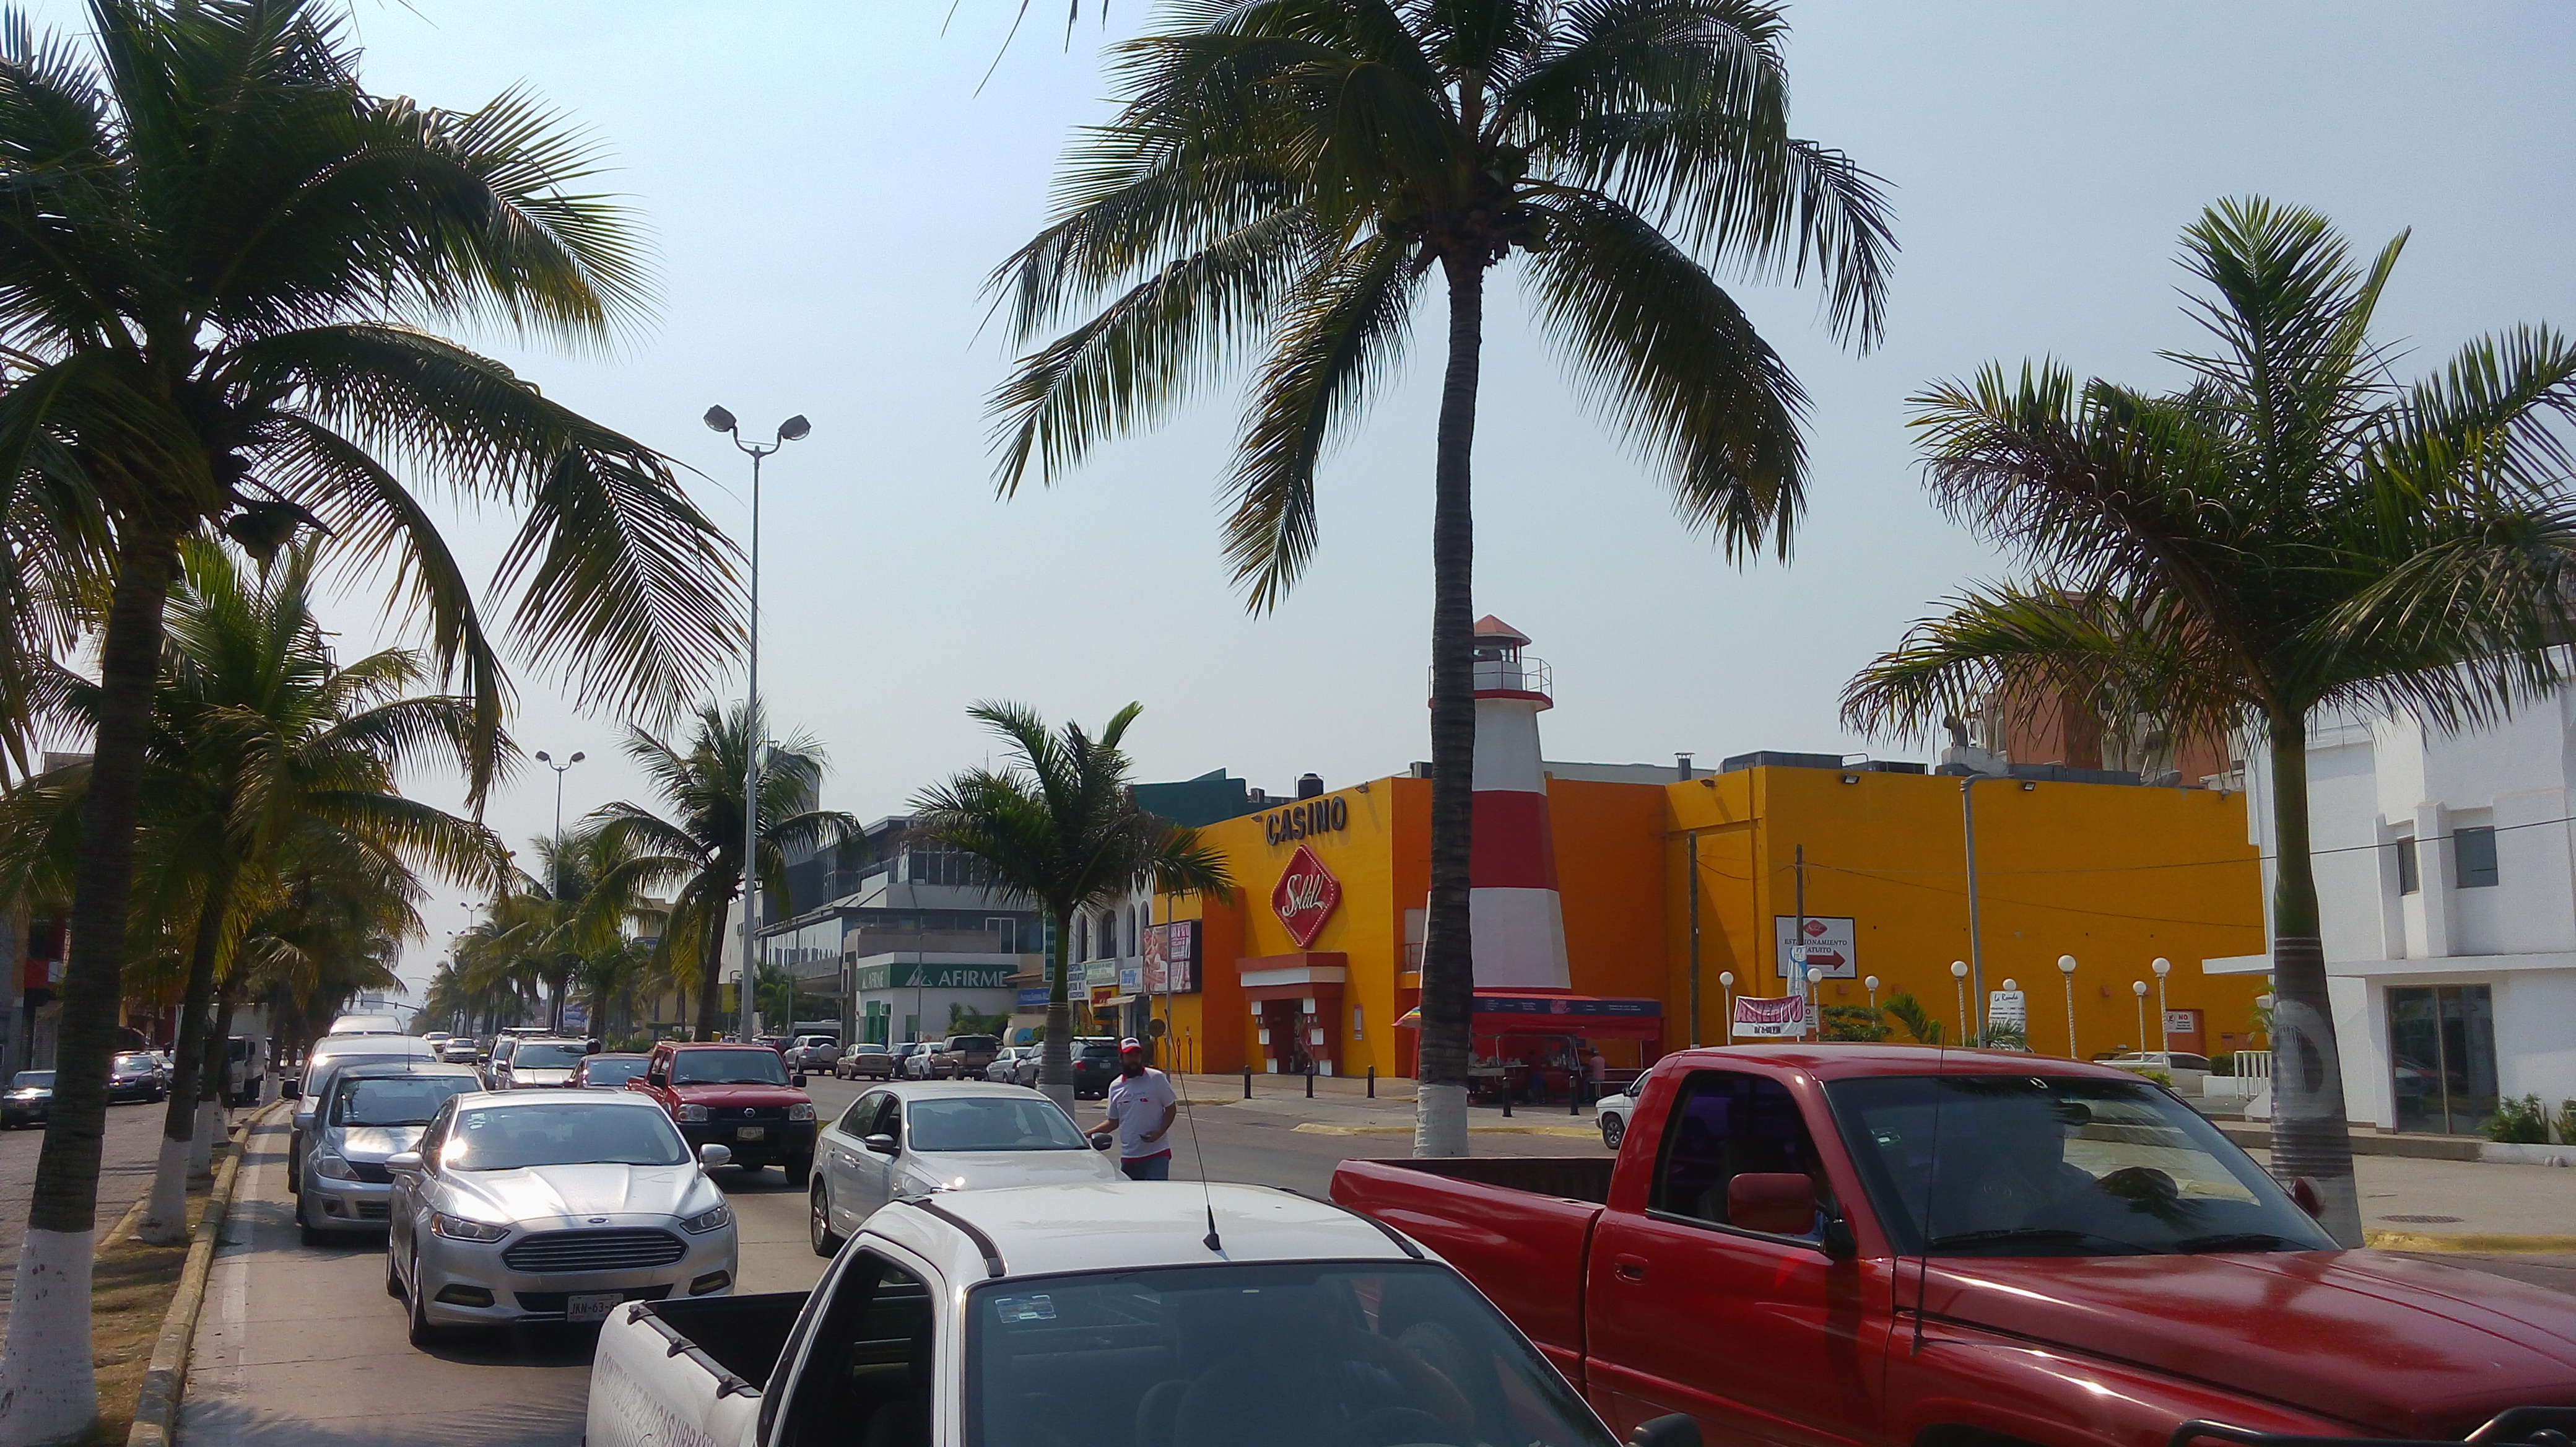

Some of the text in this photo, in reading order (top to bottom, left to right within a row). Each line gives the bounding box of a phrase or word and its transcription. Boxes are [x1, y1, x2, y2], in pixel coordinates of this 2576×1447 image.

[1266, 796, 1347, 846] CASINO
[938, 970, 1007, 987] AFIRME
[570, 1301, 619, 1314] JKN-63-6
